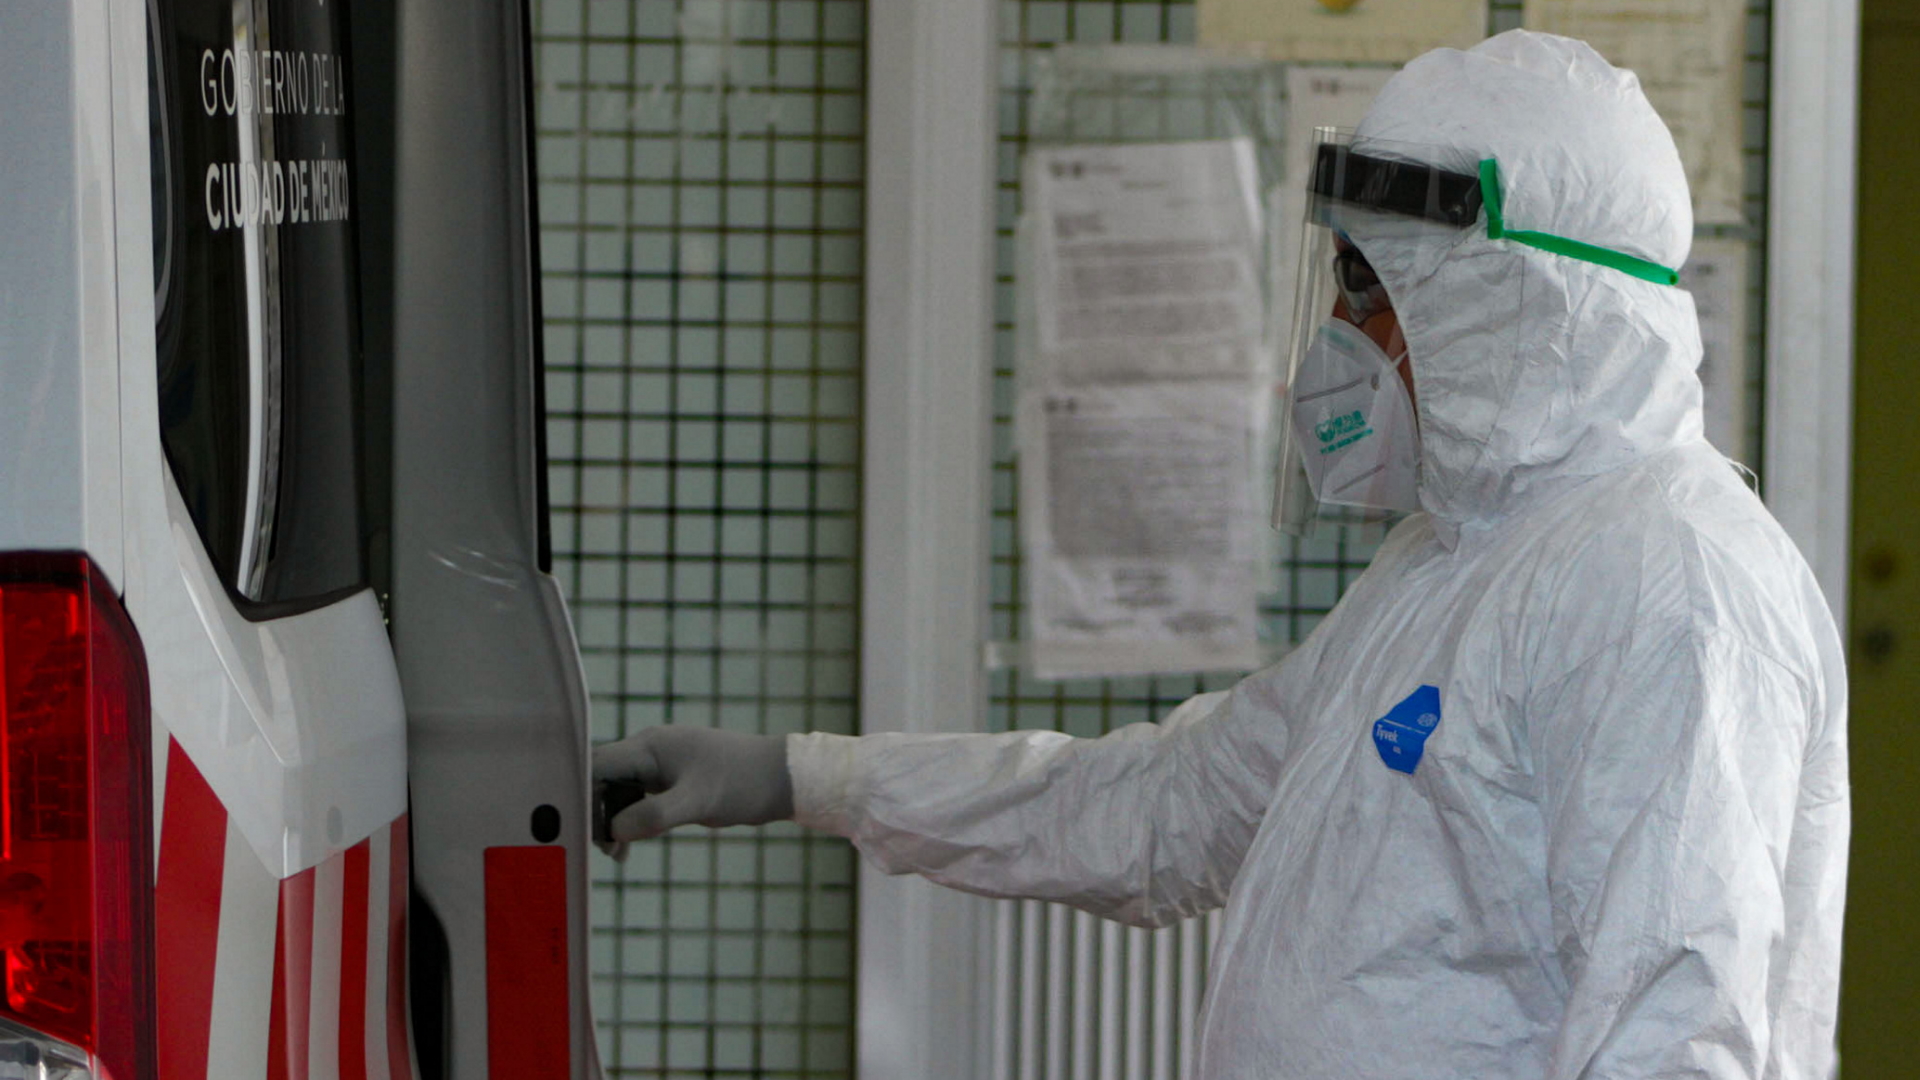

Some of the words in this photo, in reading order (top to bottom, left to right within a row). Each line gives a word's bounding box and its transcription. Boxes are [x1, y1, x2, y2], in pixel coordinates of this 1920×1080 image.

[201, 48, 309, 116] GOBIERNO
[313, 54, 329, 115] DE
[333, 56, 344, 115] LA
[205, 161, 285, 231] CIUDAD
[288, 160, 310, 224] DE
[312, 142, 349, 221] MÉXICO
[1376, 723, 1399, 743] Tyvek
